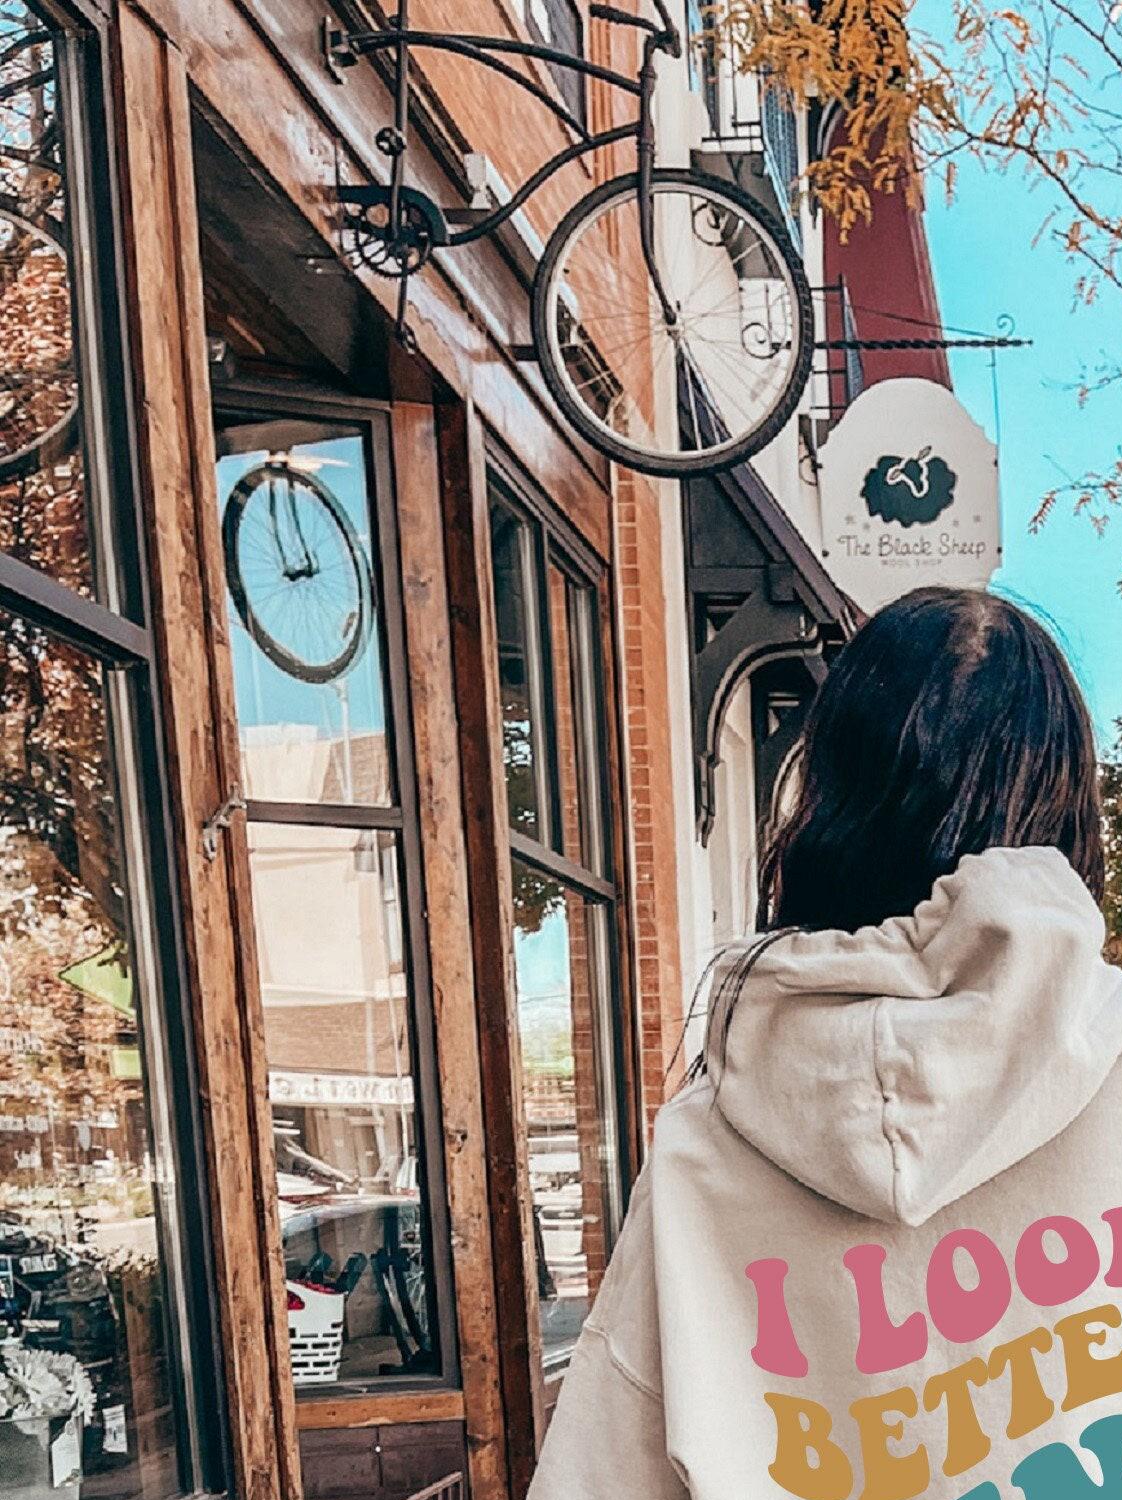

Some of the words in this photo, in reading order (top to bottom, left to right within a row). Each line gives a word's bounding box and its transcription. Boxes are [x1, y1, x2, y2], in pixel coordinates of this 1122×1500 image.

[837, 534, 871, 557] The
[878, 533, 932, 557] Black
[939, 532, 986, 559] Sheep
[746, 1258, 808, 1378] I
